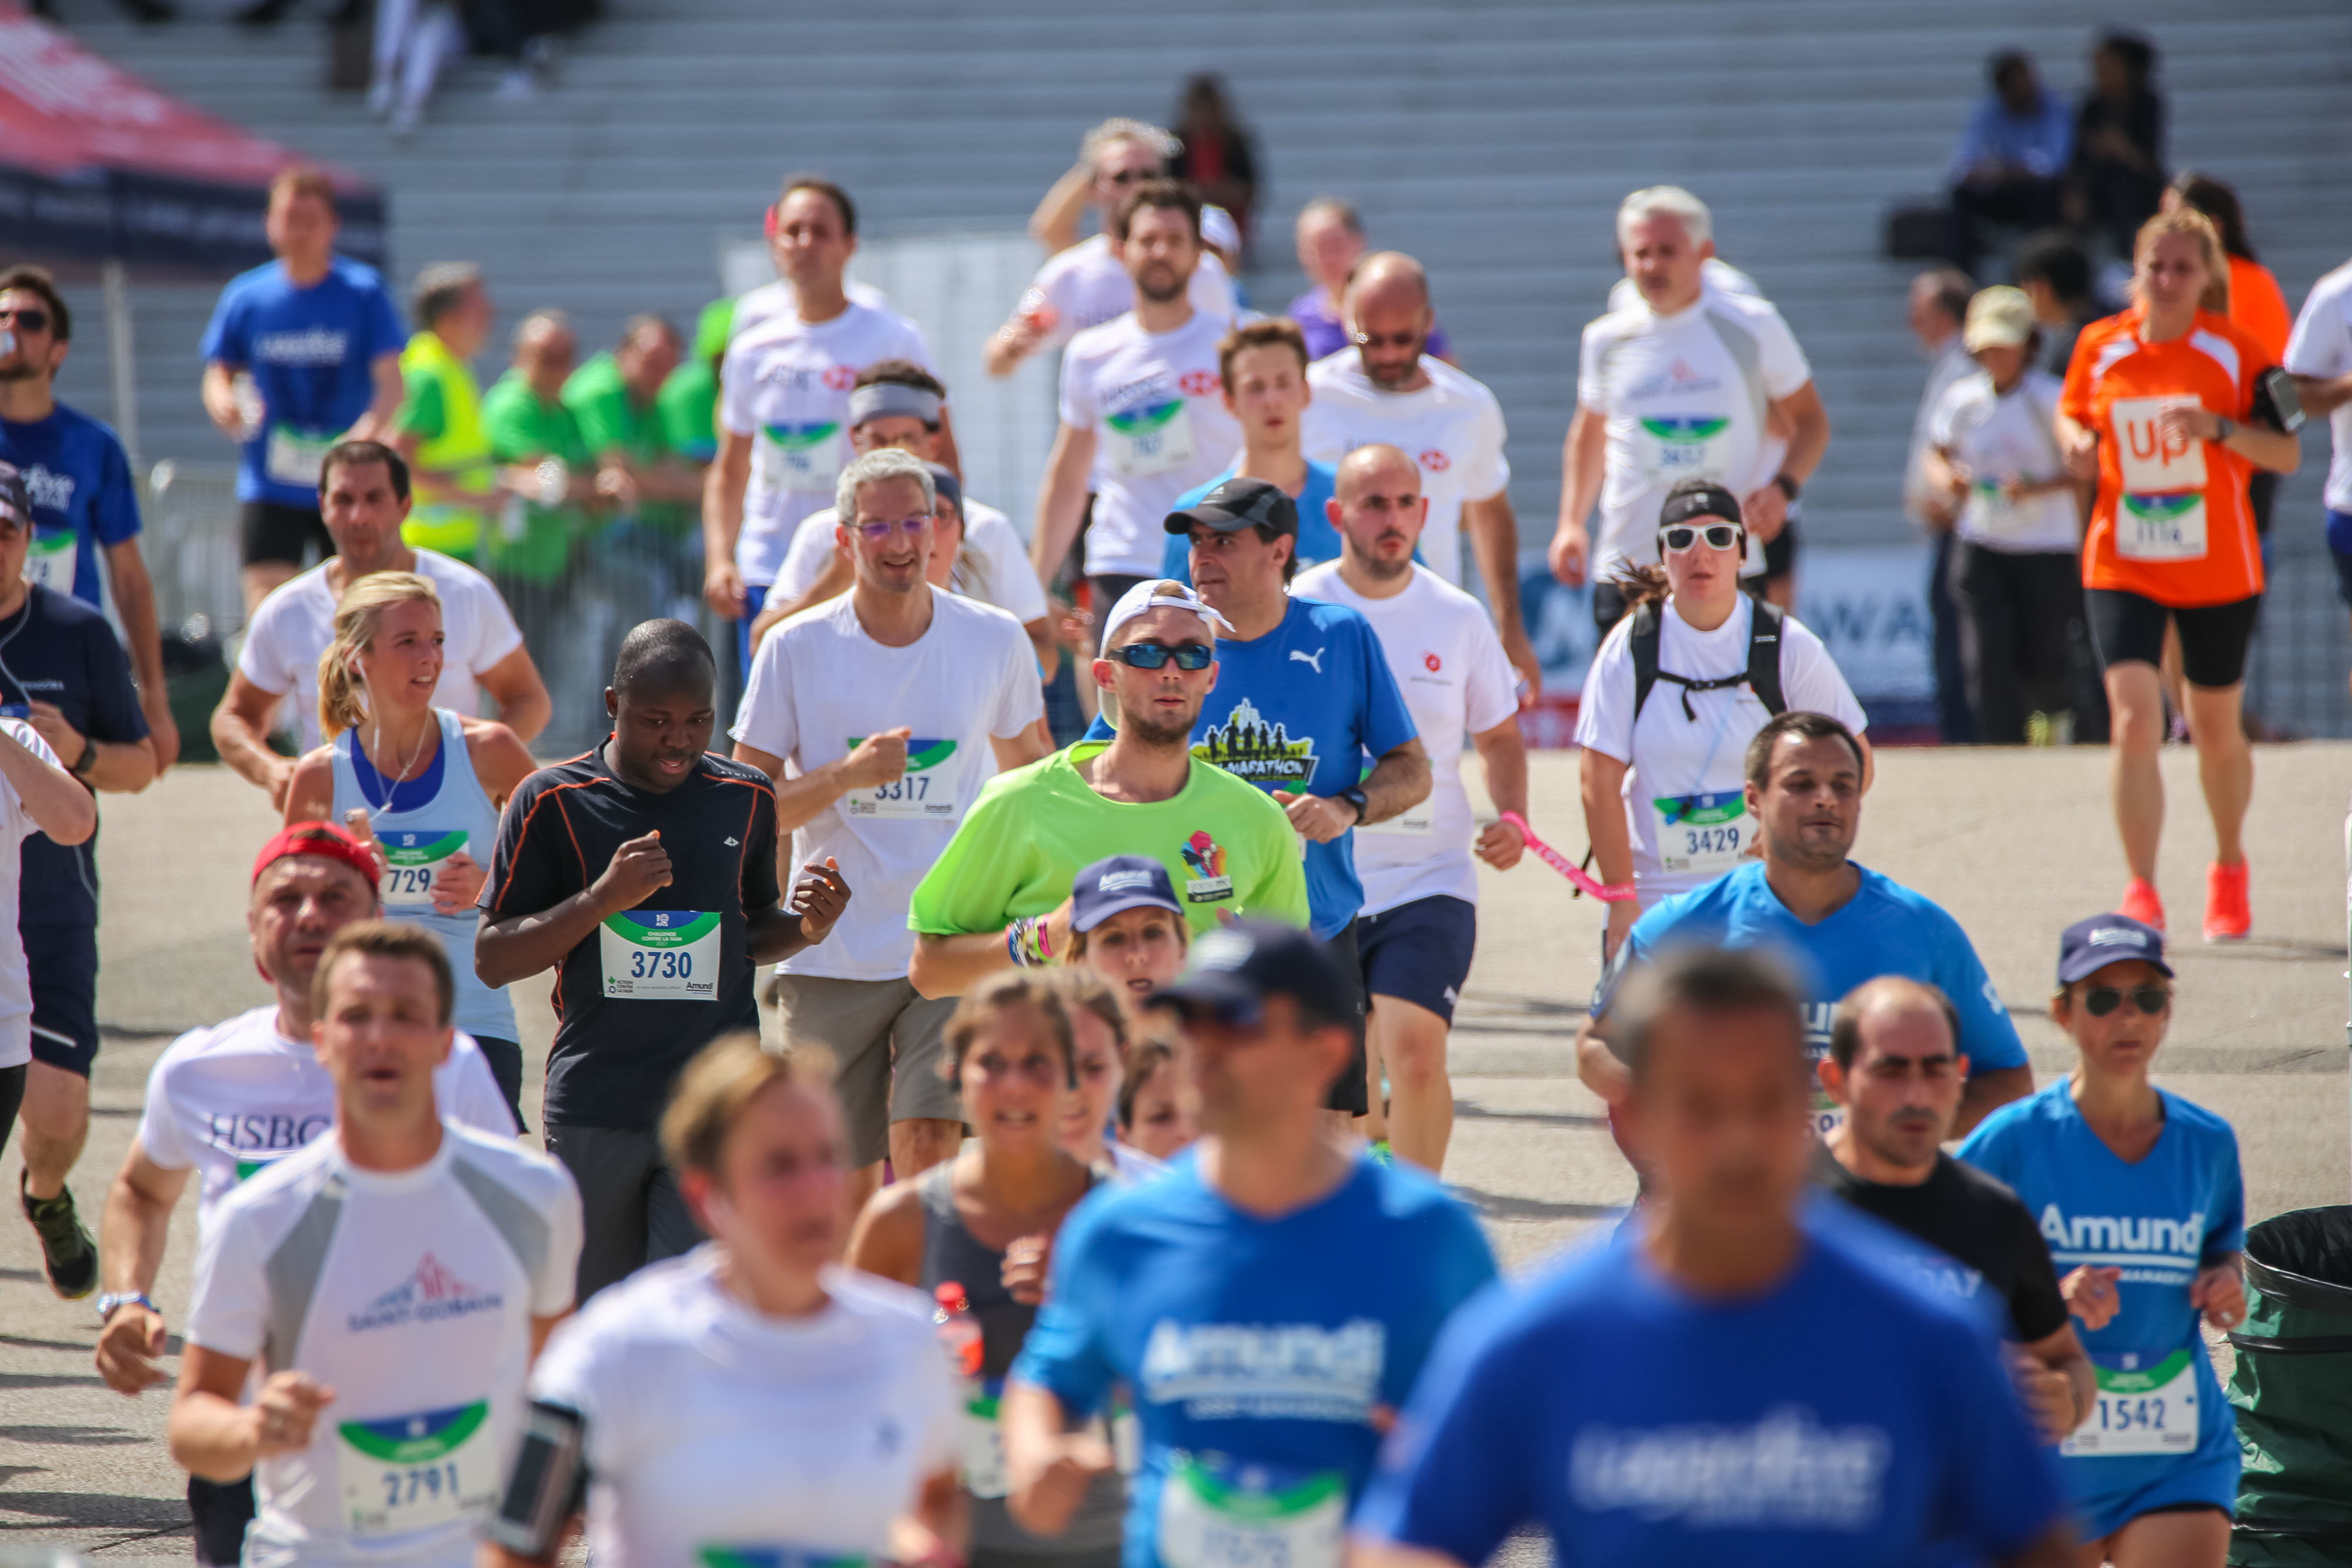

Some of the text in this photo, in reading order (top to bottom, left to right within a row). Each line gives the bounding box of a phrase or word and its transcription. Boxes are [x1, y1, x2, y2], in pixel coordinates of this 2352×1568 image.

[875, 777, 930, 801] 3317
[1687, 828, 1739, 855] 3429
[388, 868, 431, 892] 729
[631, 951, 692, 979] 3730
[211, 1114, 331, 1148] HSBC
[2098, 1398, 2166, 1430] 1542
[383, 1463, 457, 1506] 2791
